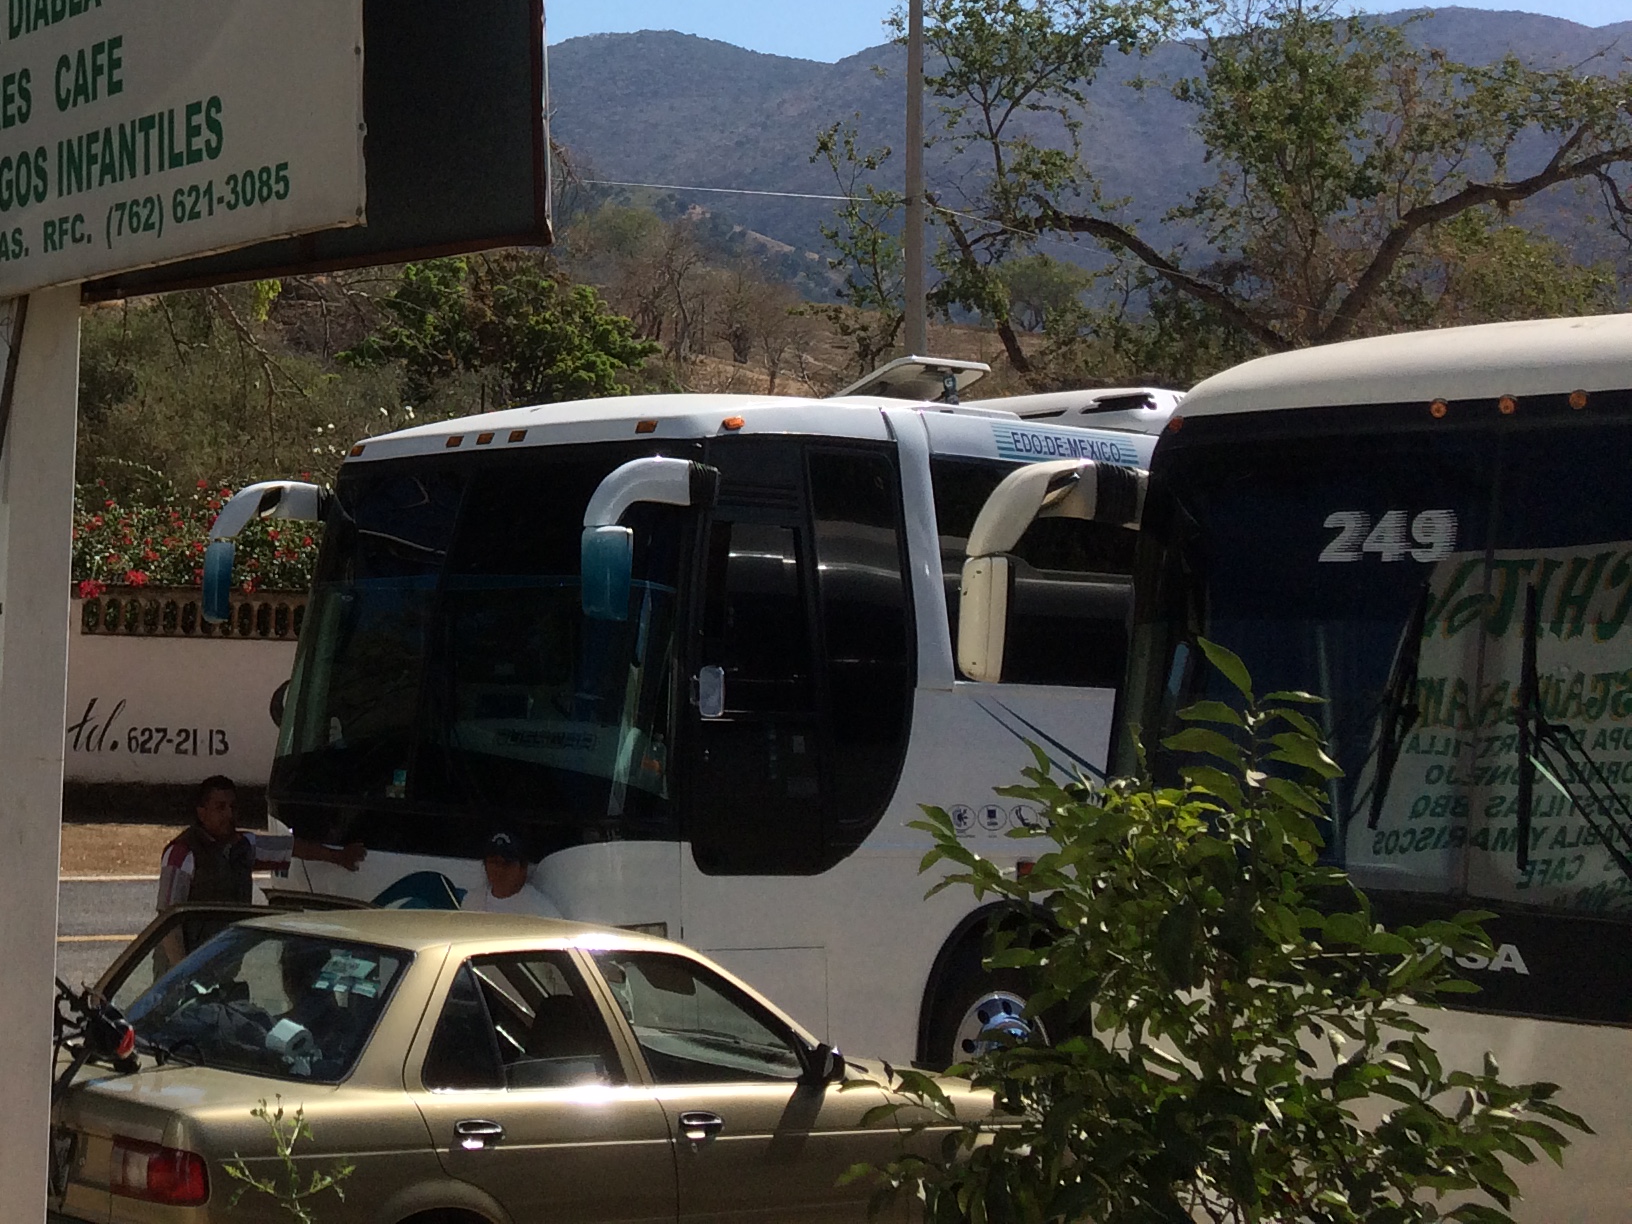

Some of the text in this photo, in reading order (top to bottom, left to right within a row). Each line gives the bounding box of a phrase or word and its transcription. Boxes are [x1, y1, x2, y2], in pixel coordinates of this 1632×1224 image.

[54, 35, 123, 112] CAFE
[57, 96, 223, 198] INFANTILES
[43, 213, 92, 253] RFC.
[106, 194, 164, 250] (762)
[172, 162, 290, 224] 621-3085
[1318, 509, 1459, 563] 249
